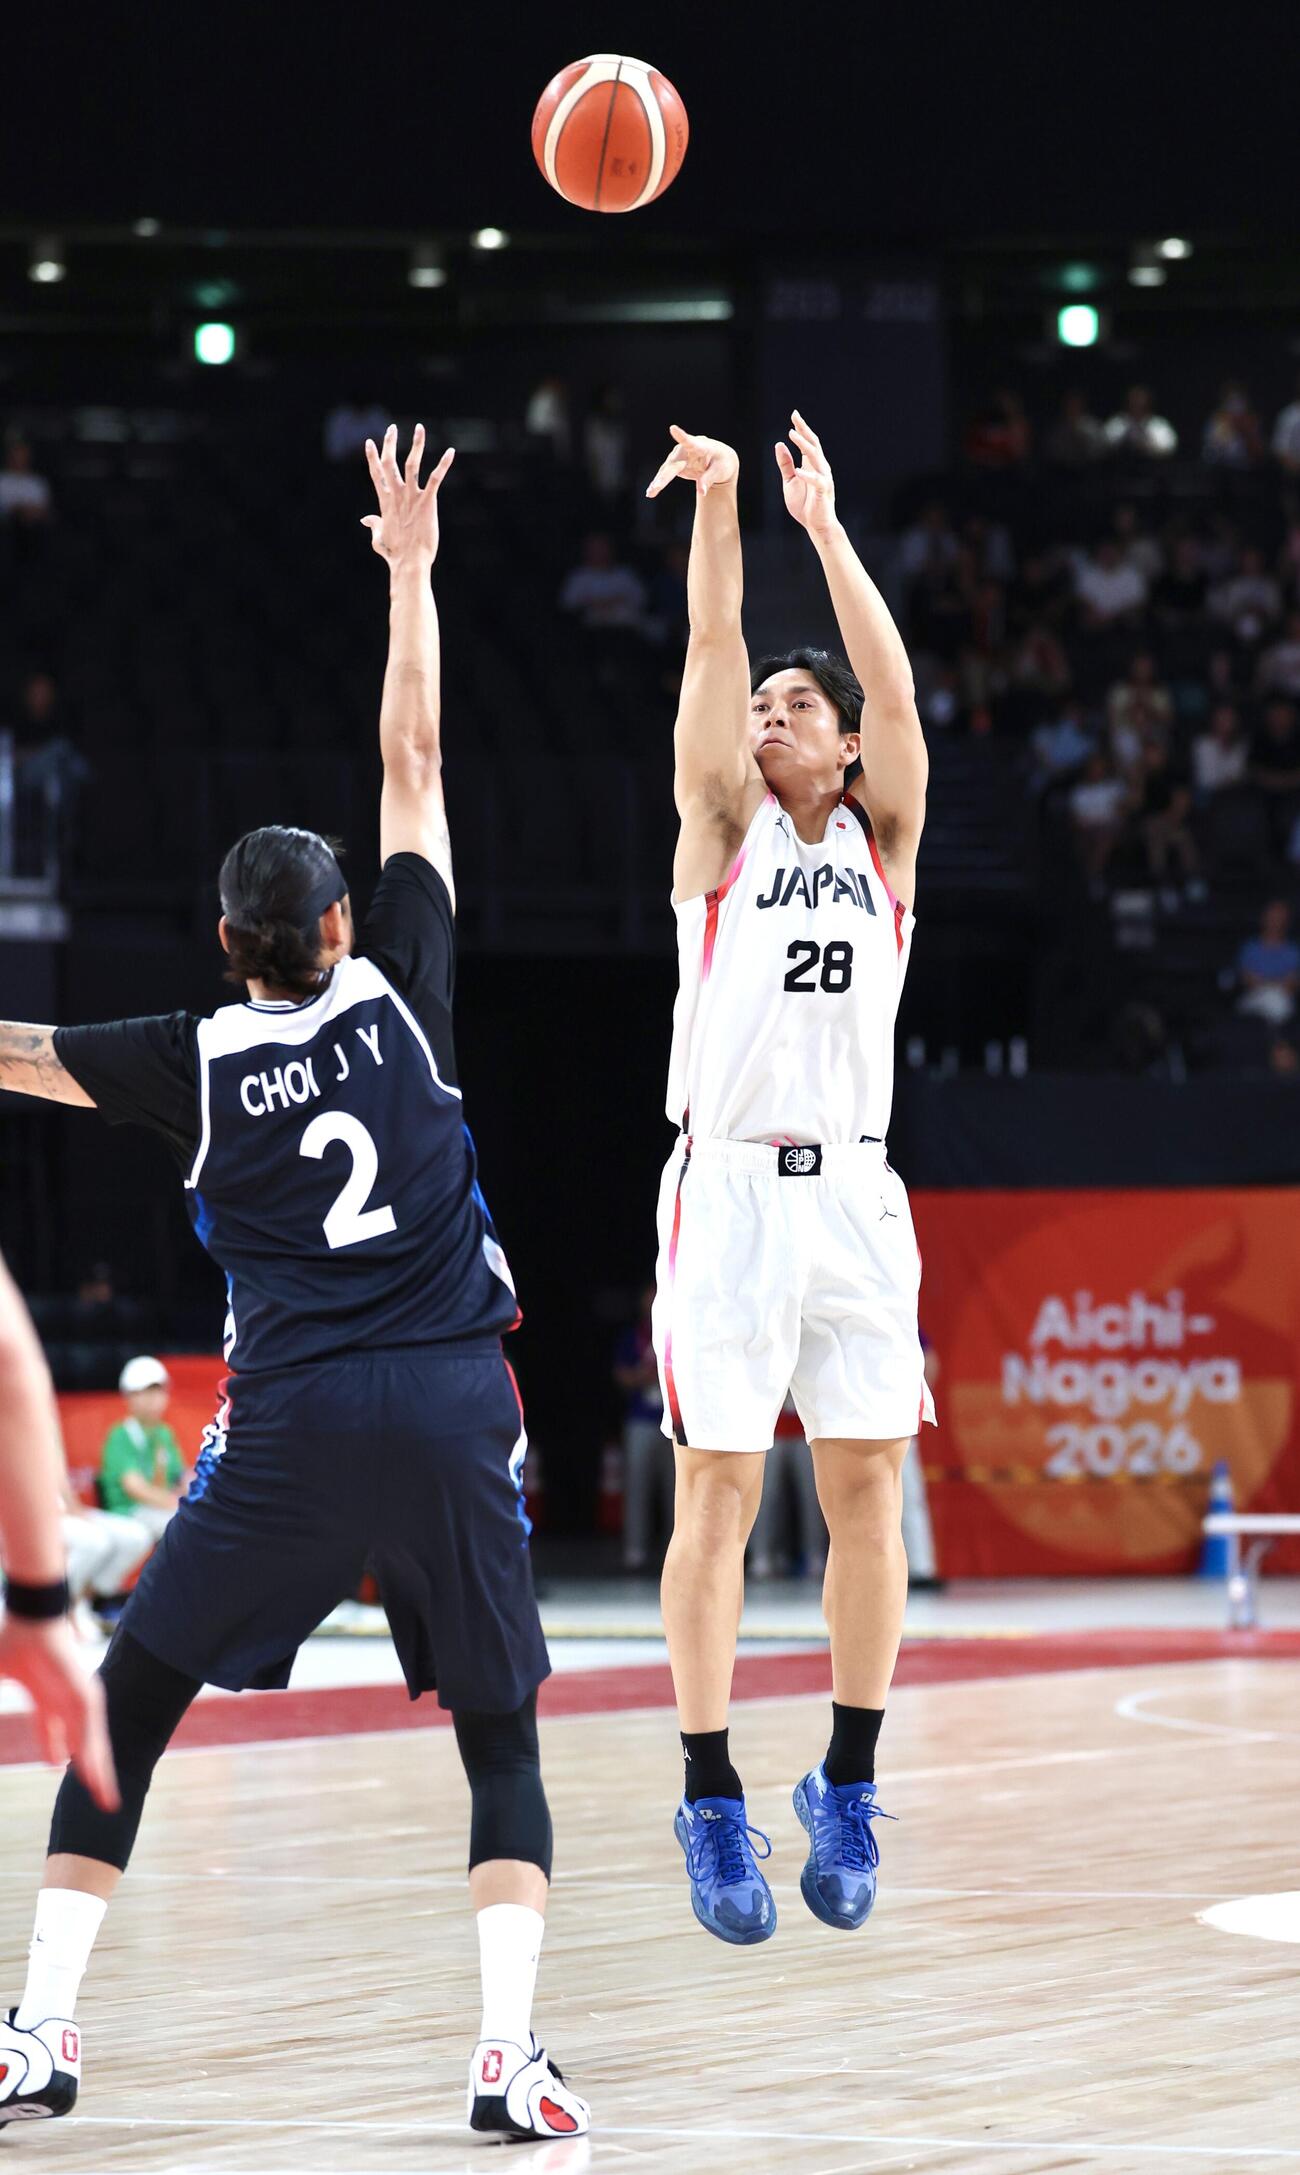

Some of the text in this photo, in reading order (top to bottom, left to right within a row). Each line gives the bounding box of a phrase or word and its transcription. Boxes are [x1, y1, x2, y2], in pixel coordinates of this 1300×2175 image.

[757, 863, 877, 917] JAPAN
[783, 939, 854, 994] 28
[240, 1023, 384, 1117] CHOI J Y
[299, 1110, 398, 1250] 2
[1030, 1290, 1215, 1351] Aichi-
[1001, 1353, 1242, 1420] Nagoya
[1045, 1421, 1203, 1477] 2026
